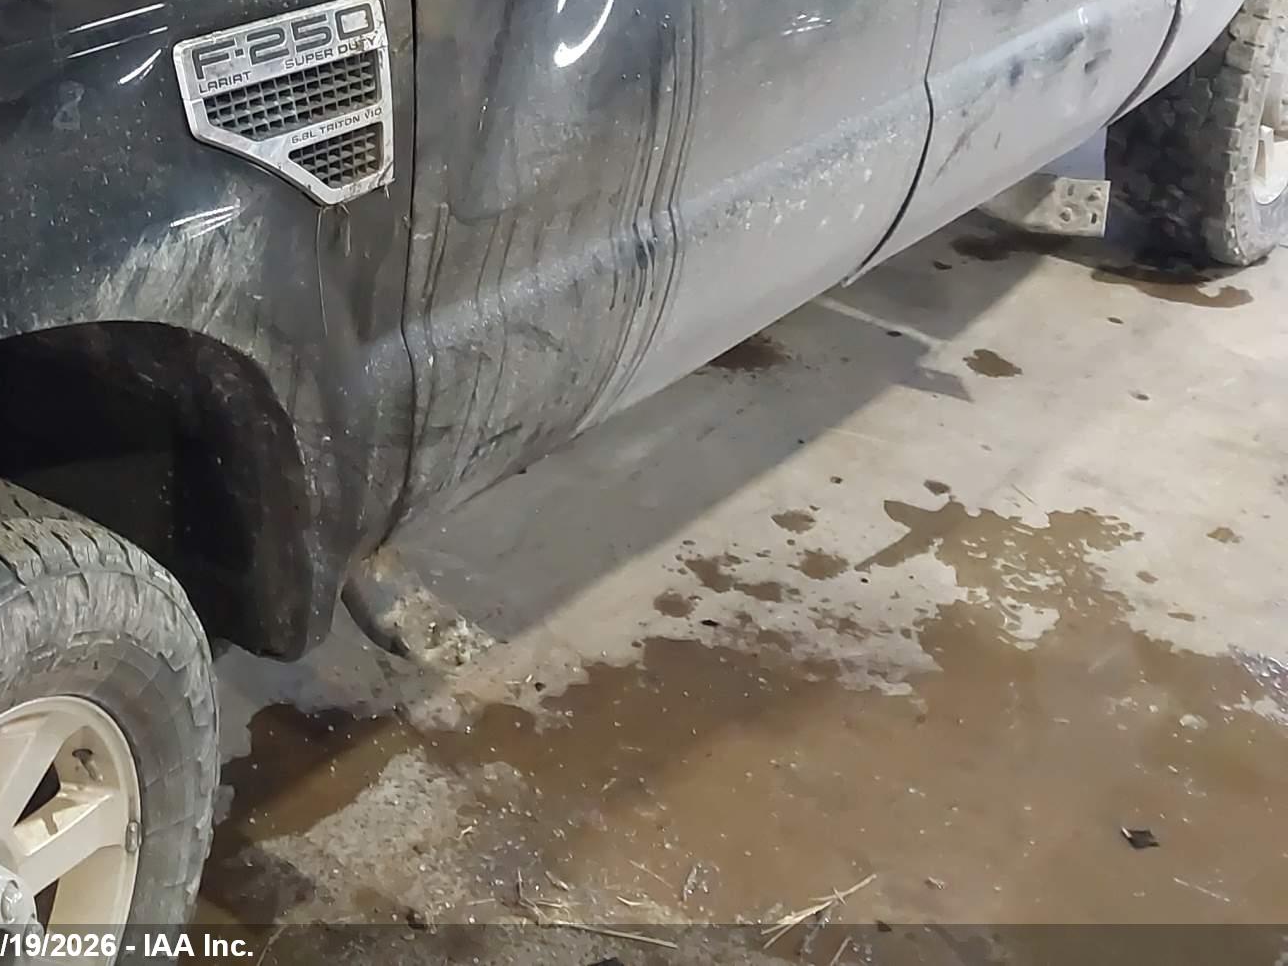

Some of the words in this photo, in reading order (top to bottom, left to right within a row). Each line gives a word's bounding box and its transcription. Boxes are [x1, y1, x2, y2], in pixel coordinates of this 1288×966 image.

[192, 3, 376, 80] F-250
[285, 48, 334, 70] SUPER
[338, 35, 377, 55] DUTY
[199, 70, 252, 94] LARIAT
[291, 129, 317, 144] 6.8L
[319, 115, 361, 135] TRITON
[364, 107, 383, 120] V10
